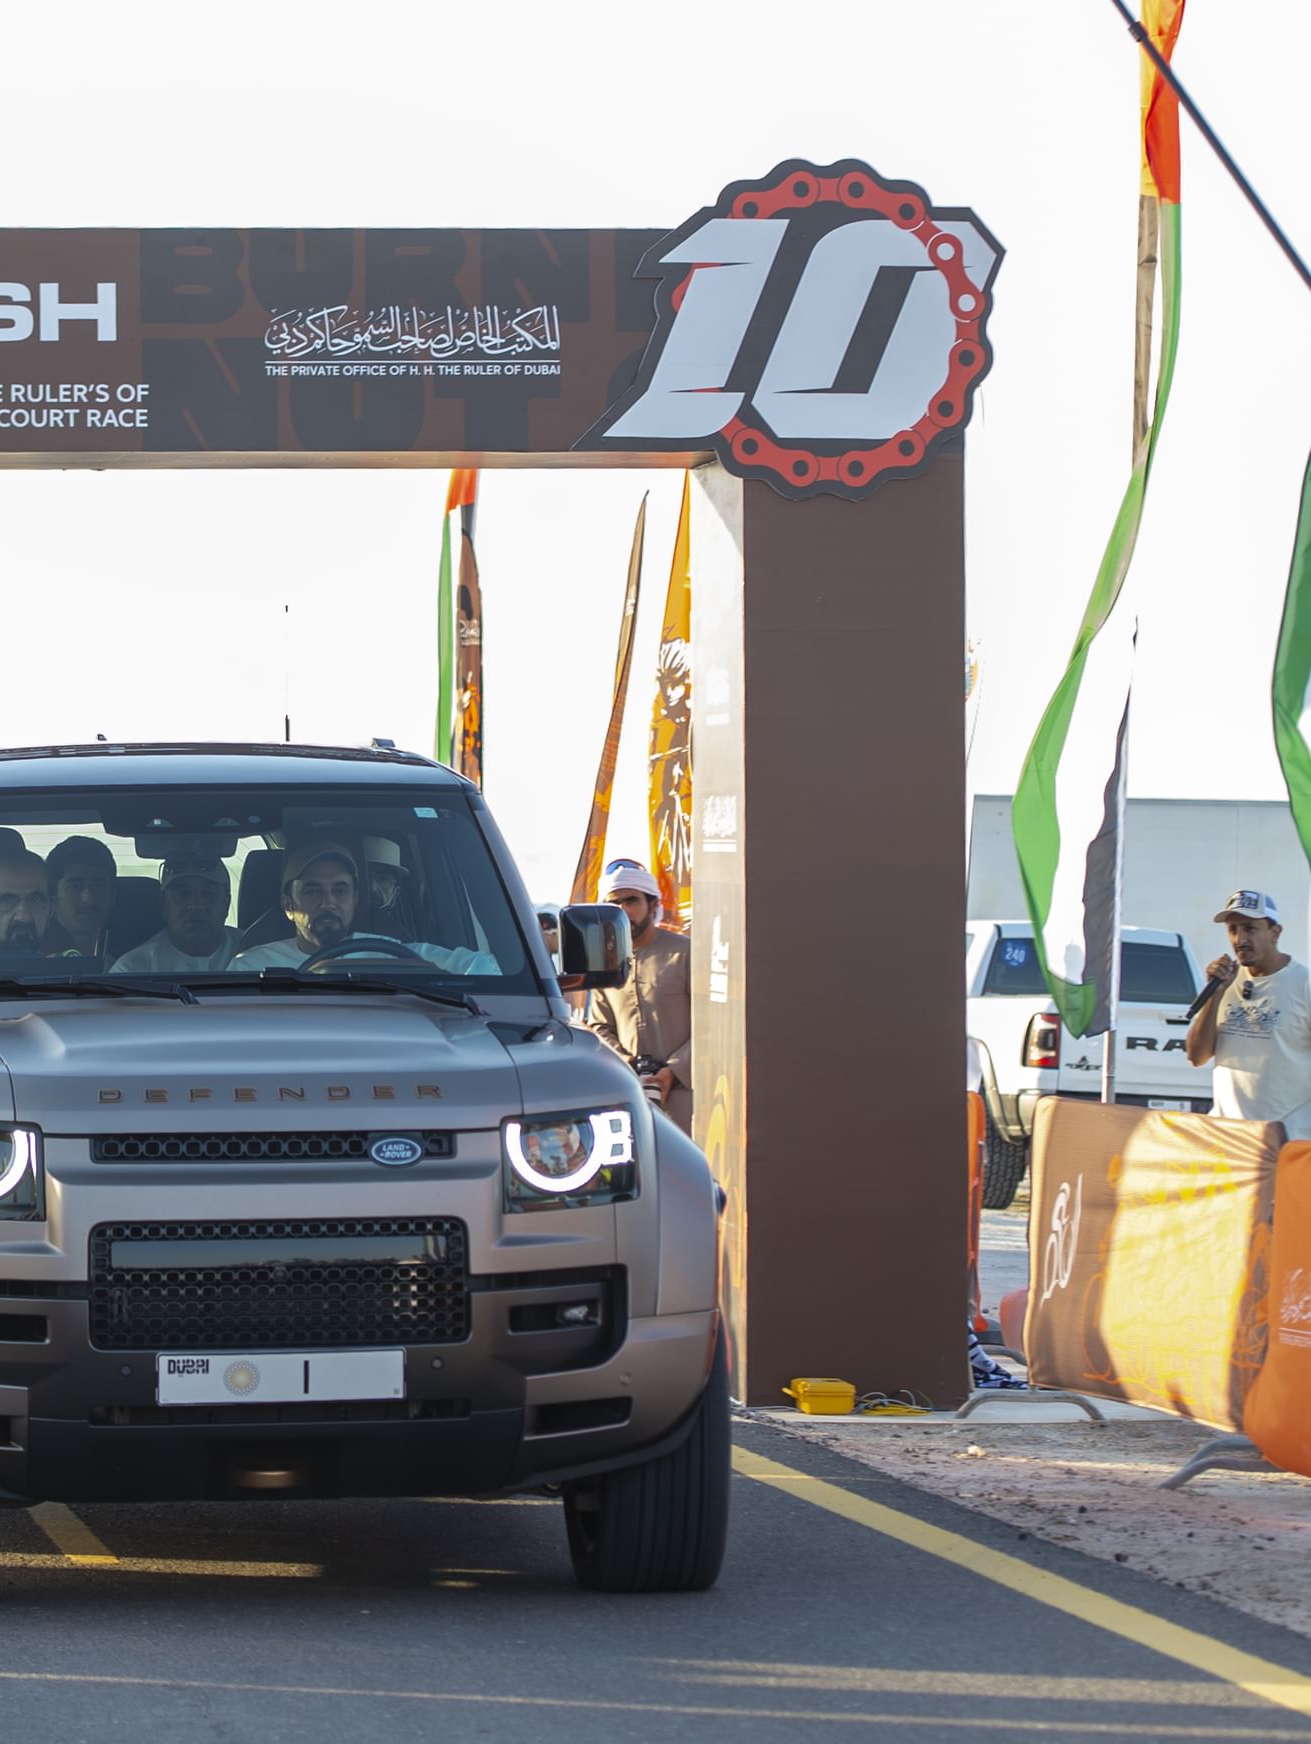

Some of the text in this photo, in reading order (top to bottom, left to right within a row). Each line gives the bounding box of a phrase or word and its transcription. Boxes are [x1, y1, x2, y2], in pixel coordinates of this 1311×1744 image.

[602, 218, 997, 439] 10
[265, 365, 288, 376] THE
[291, 365, 340, 376] PRIVATE
[342, 365, 387, 376] OFFICE
[389, 365, 407, 376] OF
[438, 365, 461, 376] THE
[463, 365, 501, 376] RULER
[504, 365, 522, 376] OF
[524, 365, 561, 376] DUBAI
[10, 384, 110, 403] RULER'S
[116, 384, 150, 403] OF
[86, 409, 149, 428] RACE
[1126, 1036, 1188, 1053] RA
[98, 1085, 444, 1104] DEFENDER
[382, 1143, 406, 1151] LAND
[385, 1150, 413, 1159] ROVER
